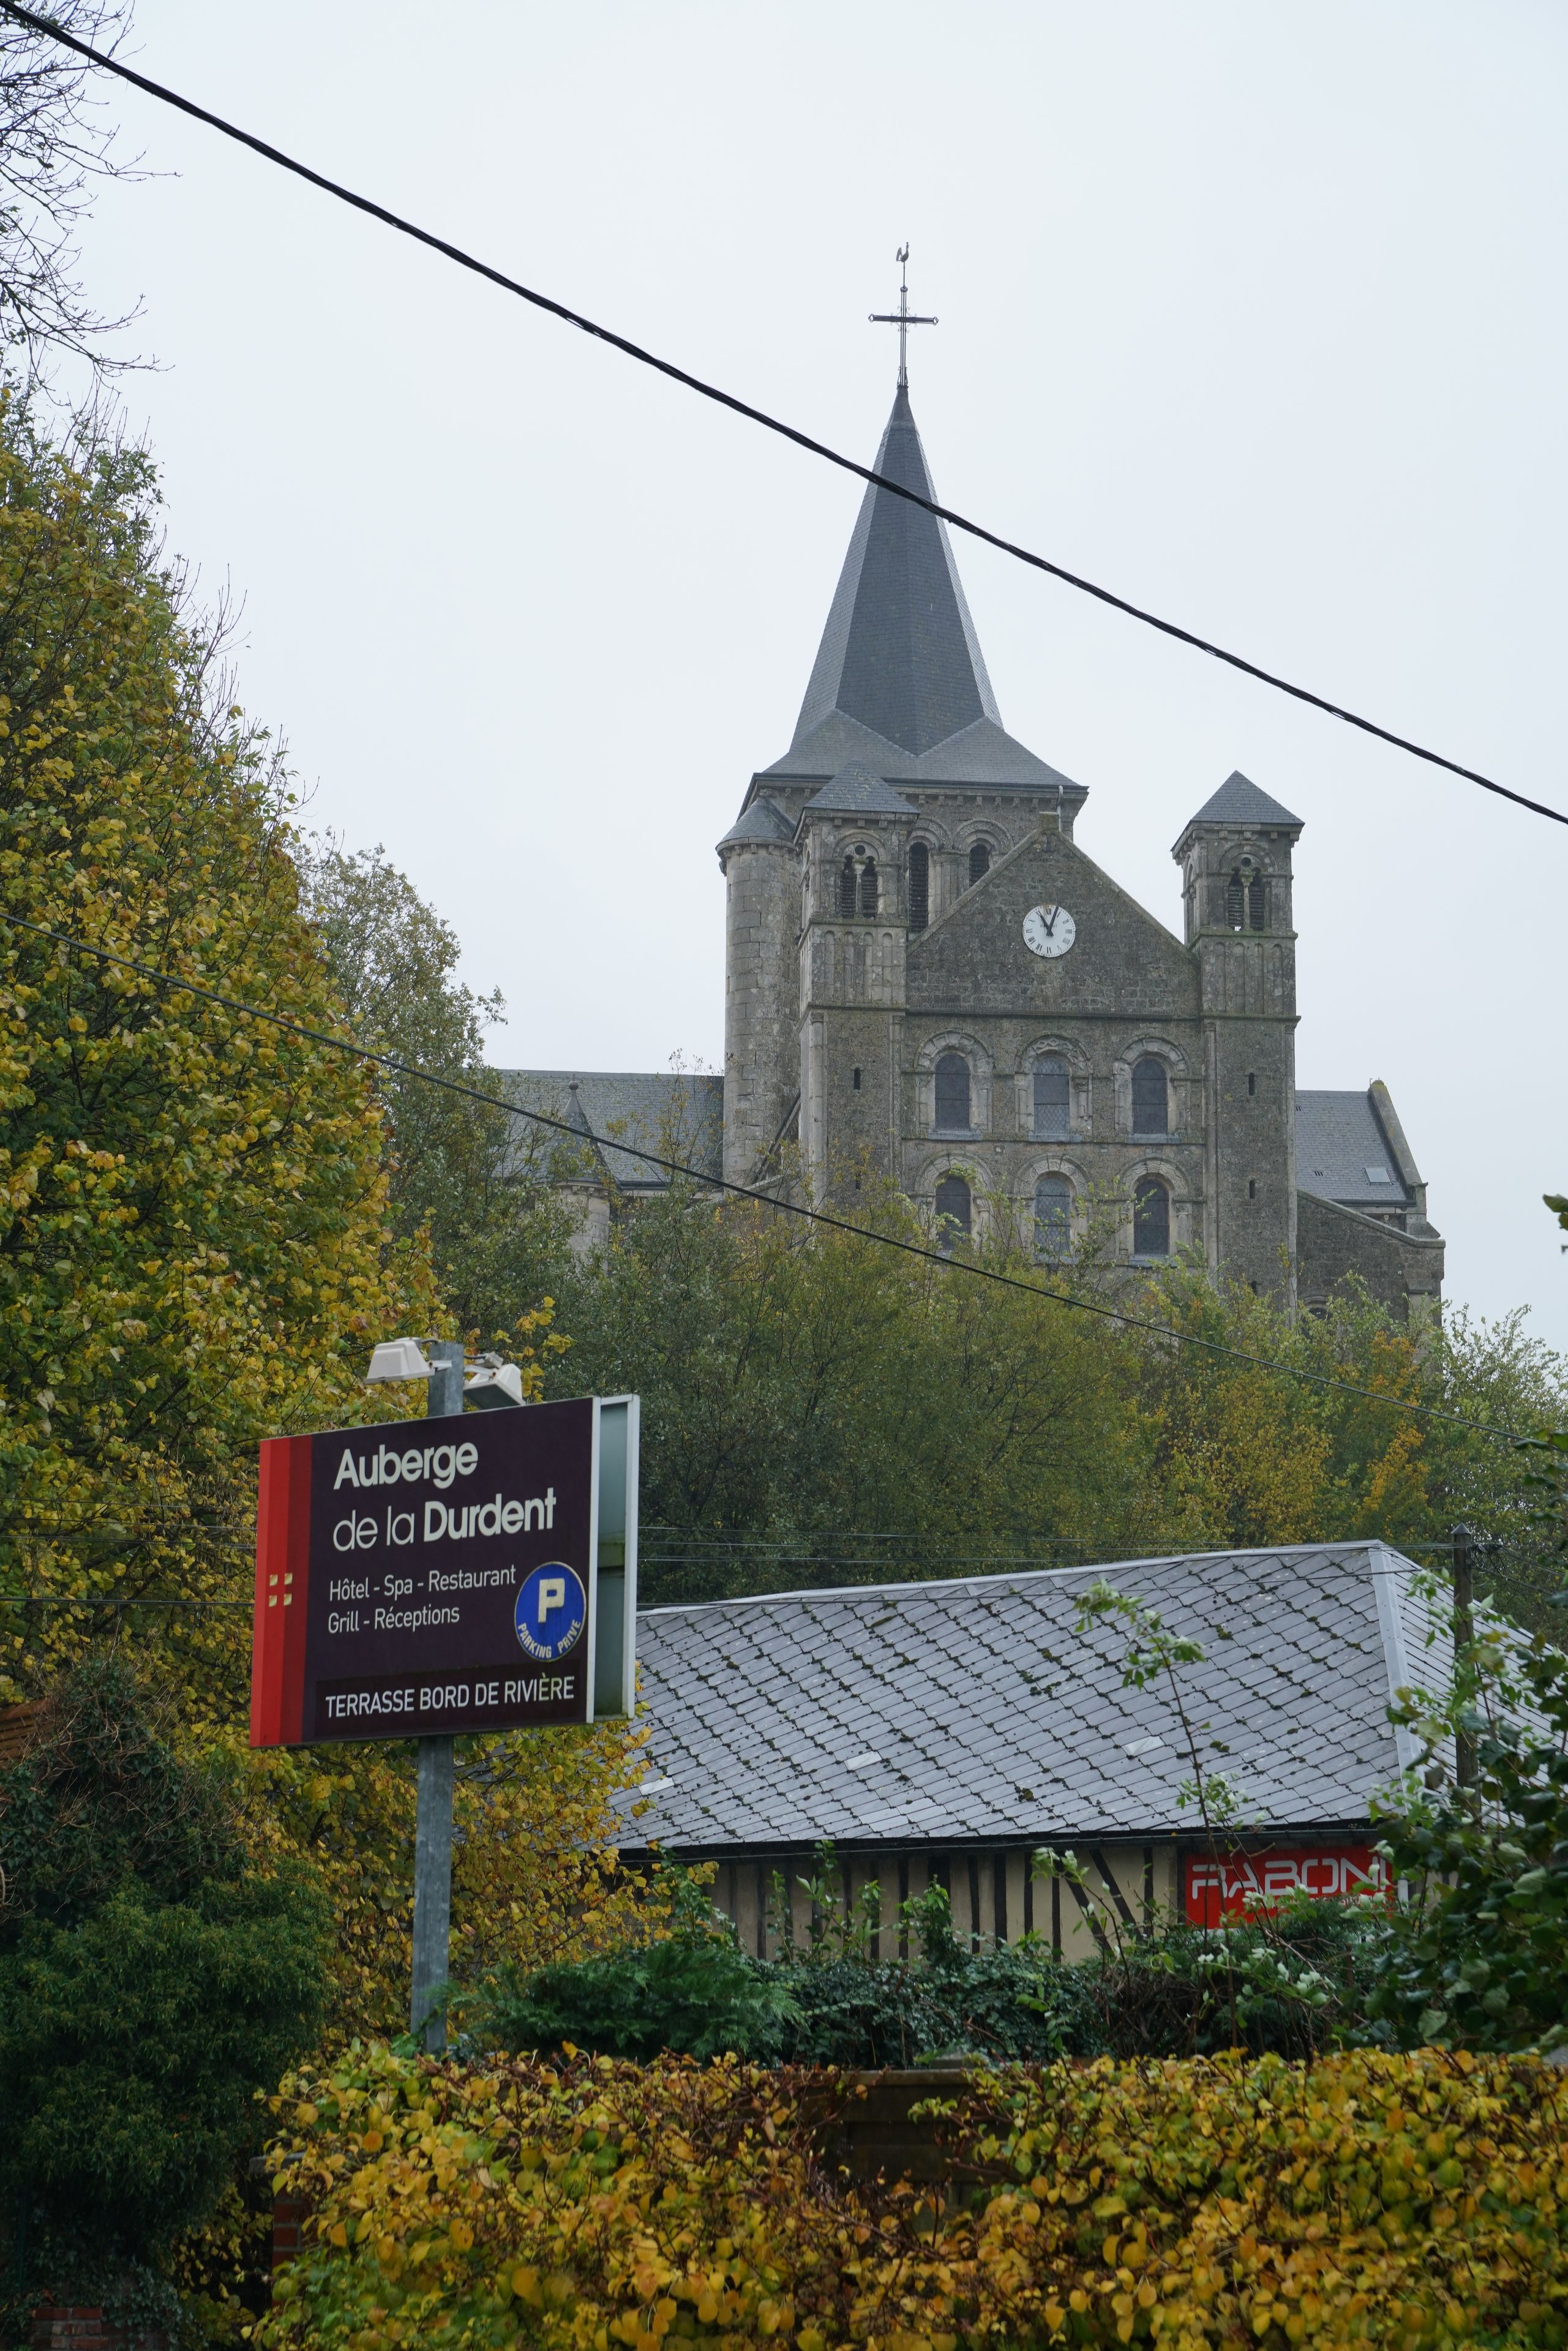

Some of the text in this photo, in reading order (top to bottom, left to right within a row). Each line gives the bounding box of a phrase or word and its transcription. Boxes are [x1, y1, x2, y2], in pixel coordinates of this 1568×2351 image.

[333, 1442, 479, 1490] Auberge
[333, 1487, 557, 1551] de la Durdent
[329, 1577, 370, 1602] Hôtel
[384, 1575, 413, 1601] Spa
[429, 1564, 516, 1592] Restaurant
[538, 1578, 565, 1623] P
[328, 1610, 359, 1633] Grill
[375, 1603, 460, 1632] Réceptions
[517, 1619, 581, 1659] PARKING PRIVE
[326, 1672, 575, 1718] TERRASSE BORD DE RIVIÈRE
[1192, 1856, 1387, 1899] RABONI
